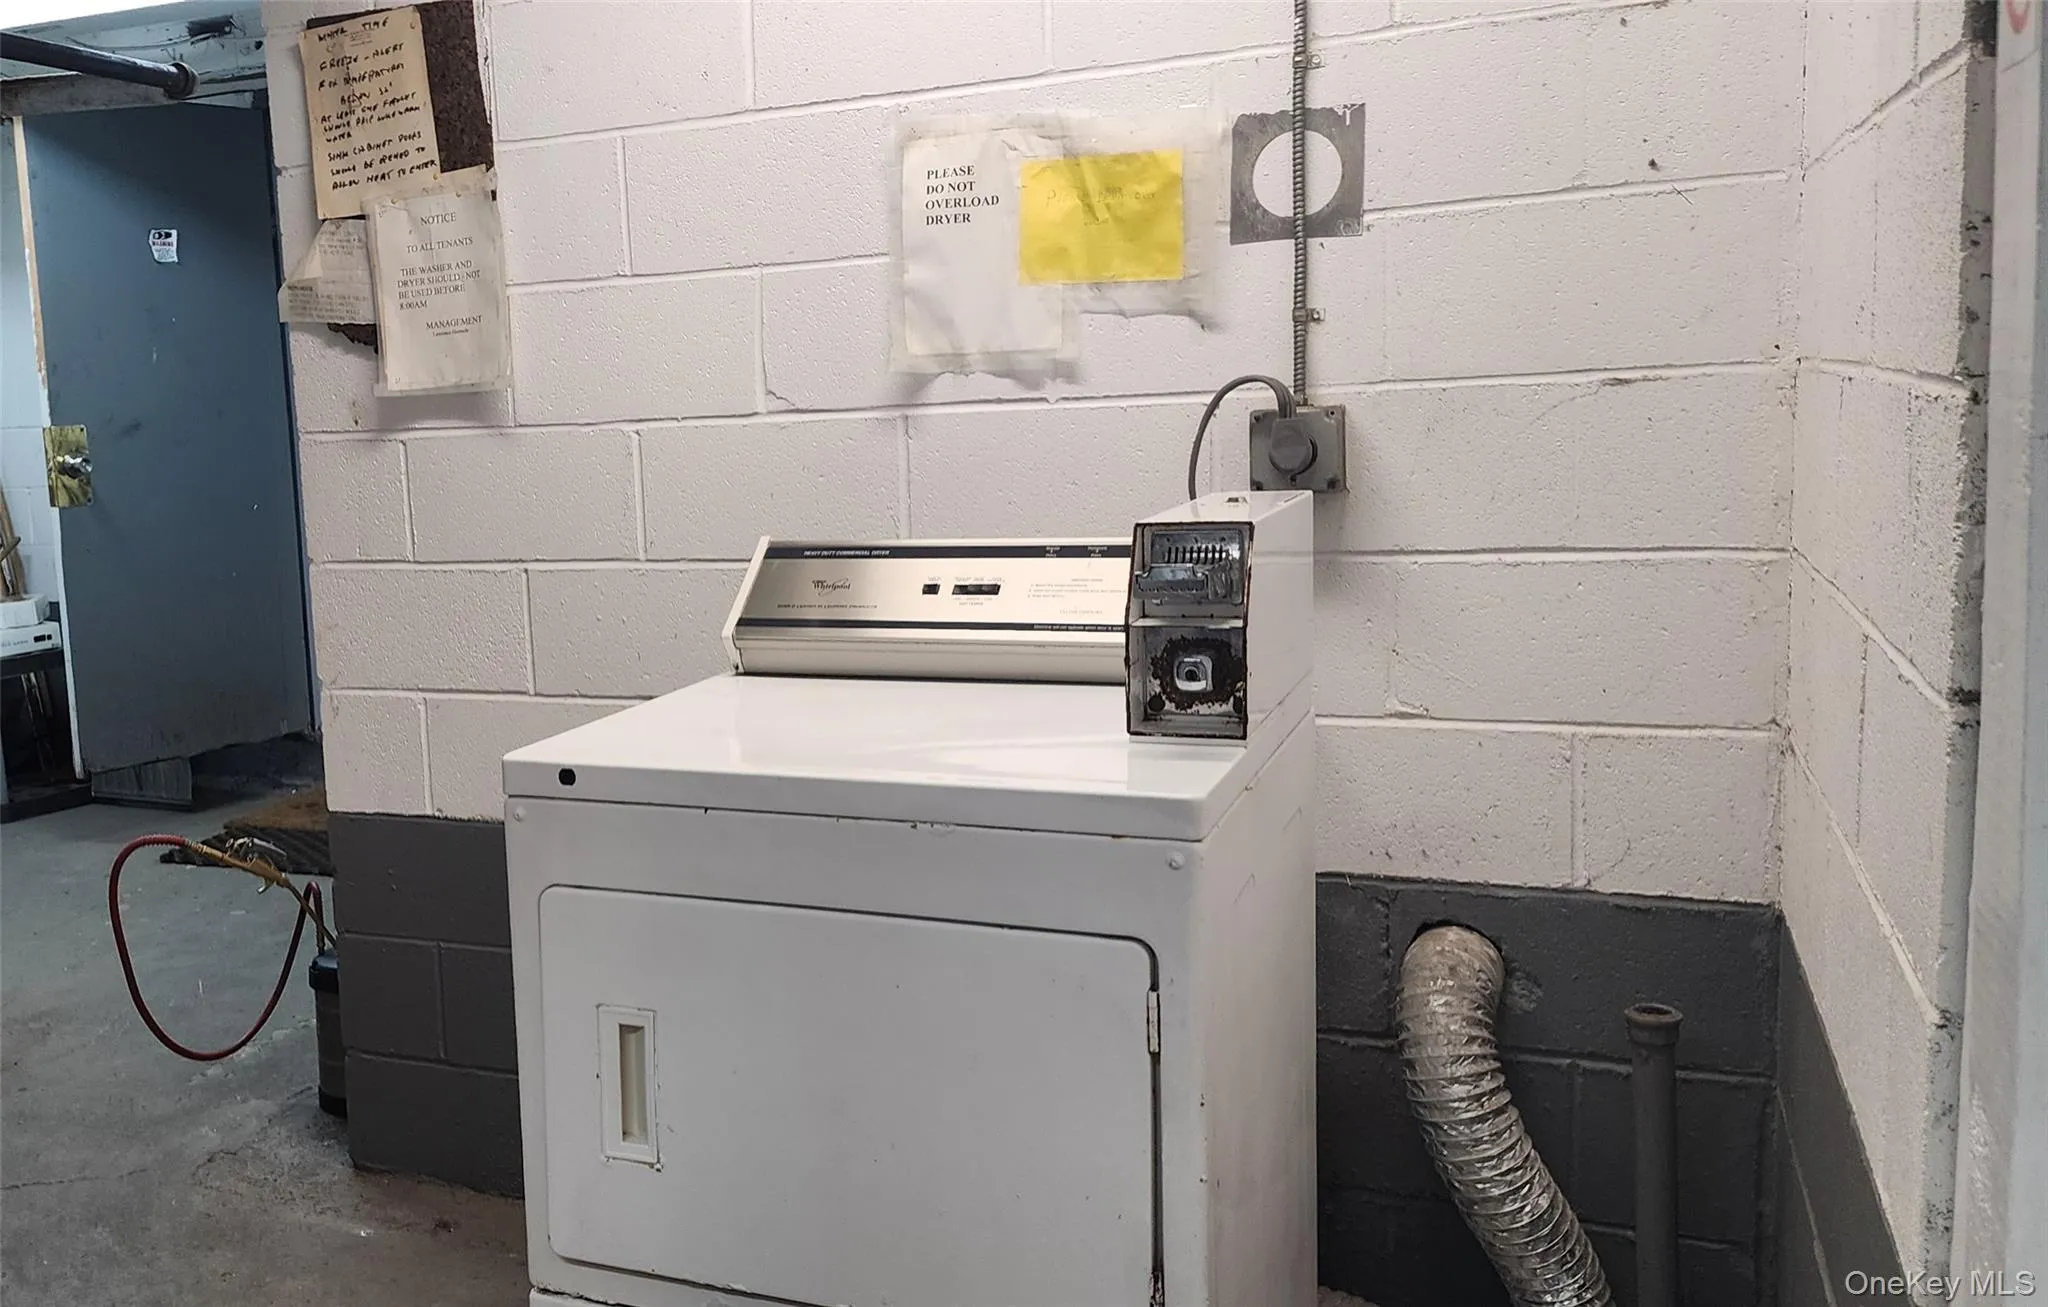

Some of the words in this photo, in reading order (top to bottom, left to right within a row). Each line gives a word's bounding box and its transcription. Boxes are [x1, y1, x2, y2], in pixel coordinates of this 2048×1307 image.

[320, 115, 332, 124] AT
[327, 150, 349, 162] SINK
[352, 138, 393, 156] CABINET
[398, 130, 422, 143] DOORS
[363, 158, 375, 169] BE
[379, 149, 410, 165] OPENED
[415, 146, 426, 154] TO
[332, 179, 360, 191] ALLOW
[366, 168, 394, 183] HEAT
[397, 168, 406, 178] TO
[409, 159, 437, 174] ENTER
[927, 165, 975, 180] PLEASE
[927, 184, 944, 195] DO
[947, 181, 976, 193] NOT
[925, 195, 1000, 210] OVERLOAD
[420, 211, 457, 226] NOTICE
[926, 213, 971, 225] DRYER
[407, 244, 418, 254] TO
[419, 241, 435, 252] ALL
[436, 236, 473, 250] TENANTS
[400, 266, 417, 277] THE
[418, 262, 453, 275] WASHER
[454, 259, 472, 270] AND
[397, 276, 426, 289] DRYER
[427, 272, 461, 285] SHOULD
[465, 269, 481, 280] NOT
[398, 290, 410, 300] BE
[411, 287, 433, 297] USED
[434, 283, 466, 296] BEFORE
[426, 315, 482, 329] MANAGEMENT
[811, 579, 851, 592] Whirlpool
